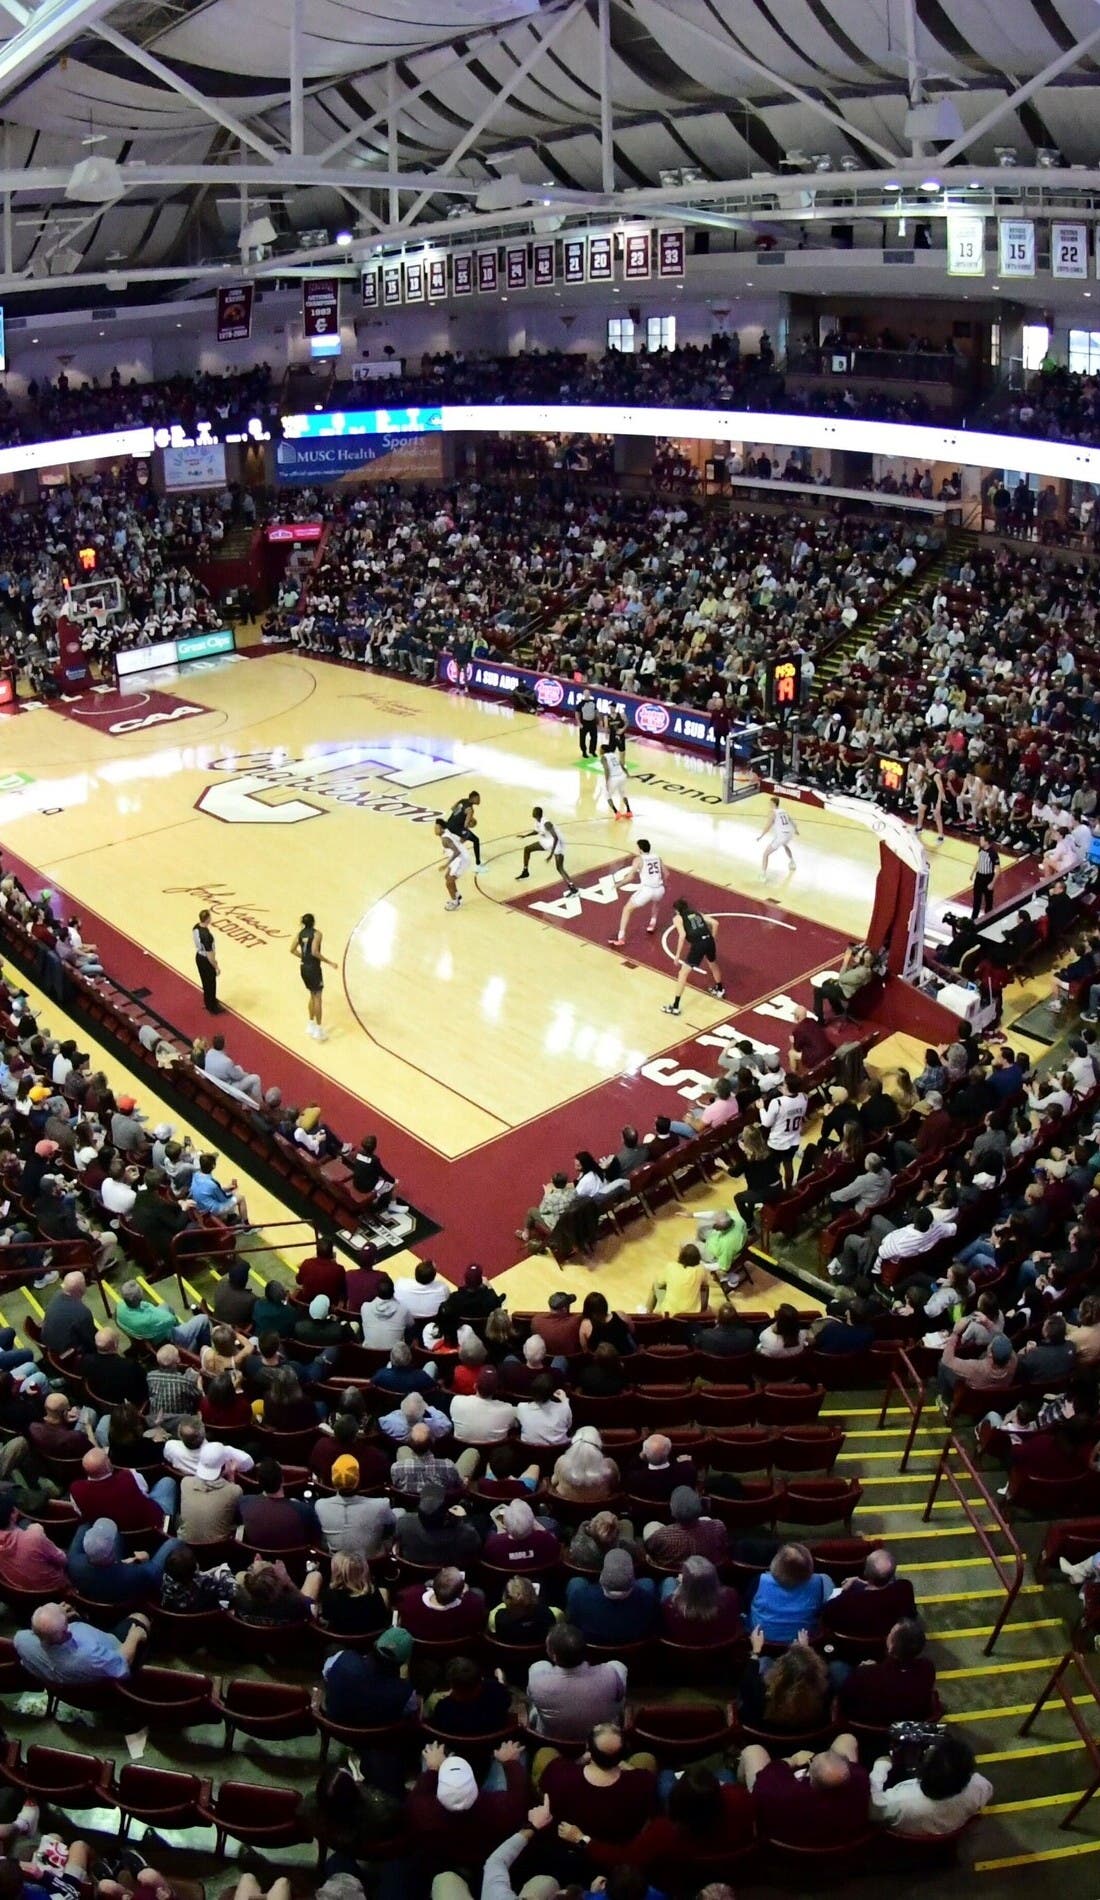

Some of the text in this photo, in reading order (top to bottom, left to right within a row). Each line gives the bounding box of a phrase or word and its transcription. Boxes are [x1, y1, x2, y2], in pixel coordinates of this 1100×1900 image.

[665, 250, 678, 264] 33
[960, 242, 973, 258] 13
[1010, 244, 1026, 260] 15
[1061, 246, 1078, 262] 22
[594, 254, 607, 268] 20
[630, 252, 644, 266] 23
[382, 434, 425, 449] Sports
[296, 448, 376, 463] MUSC Health
[483, 670, 500, 686] SUB
[109, 706, 204, 733] CAA
[684, 720, 706, 739] SUB
[632, 773, 722, 804] Arena
[780, 815, 789, 826] 11
[648, 862, 660, 875] 25
[211, 918, 267, 948] COURT
[784, 1116, 801, 1132] 10
